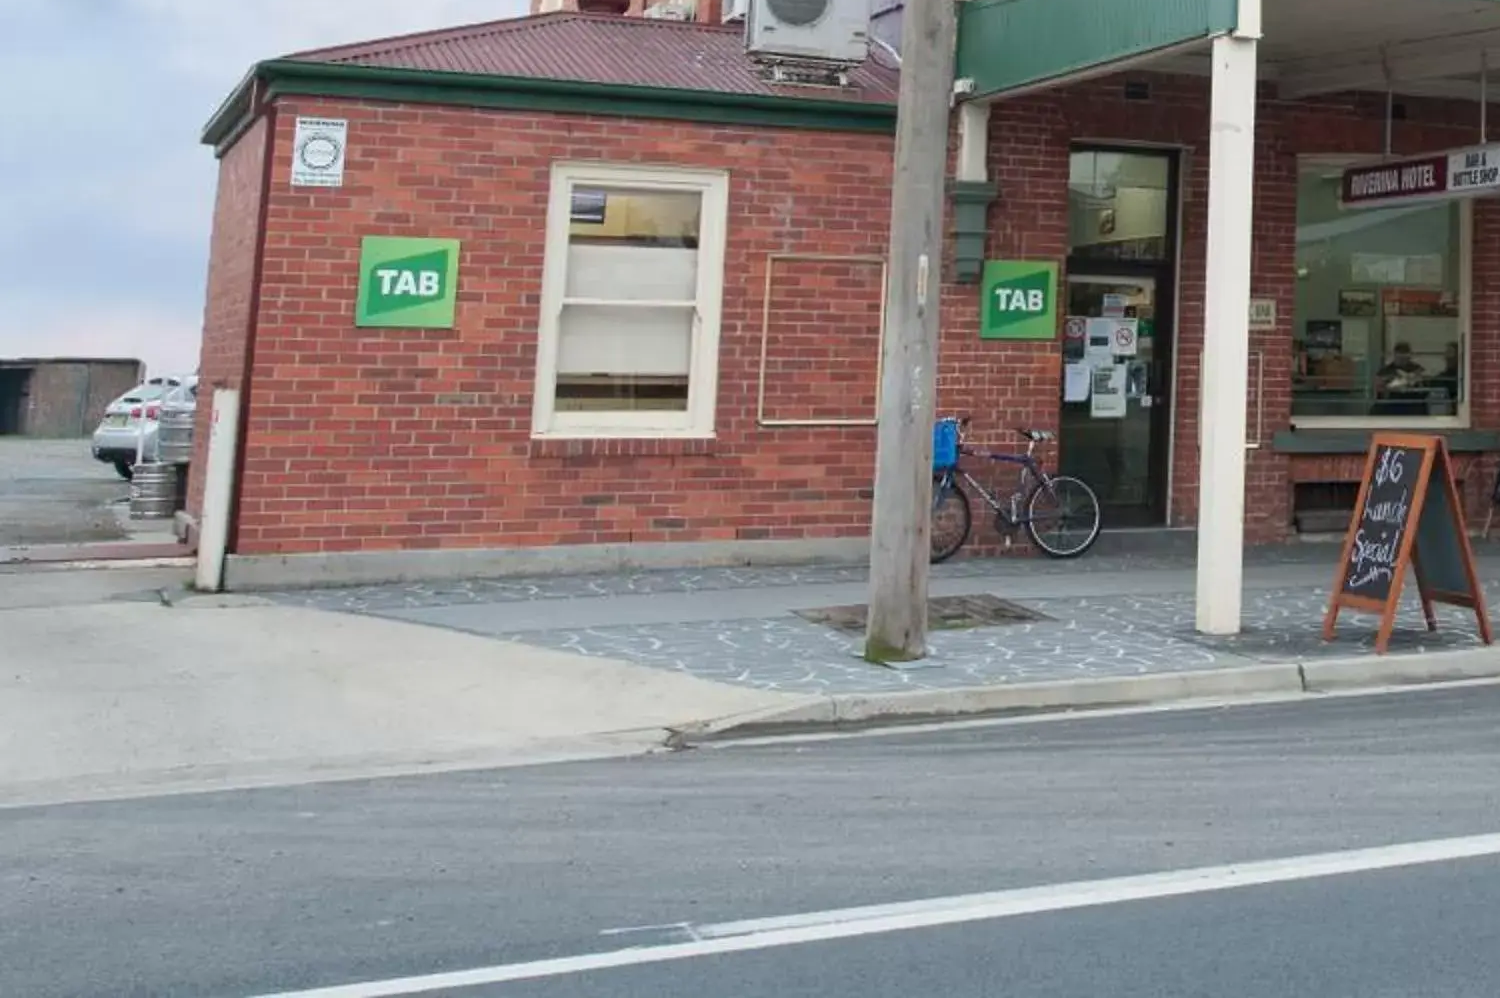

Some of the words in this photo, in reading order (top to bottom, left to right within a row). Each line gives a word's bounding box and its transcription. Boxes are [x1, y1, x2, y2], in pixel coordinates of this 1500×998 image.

[1351, 169, 1399, 196] RIVERINA
[1401, 164, 1436, 192] HOTEL
[376, 269, 440, 295] TAB
[994, 288, 1043, 311] TAB
